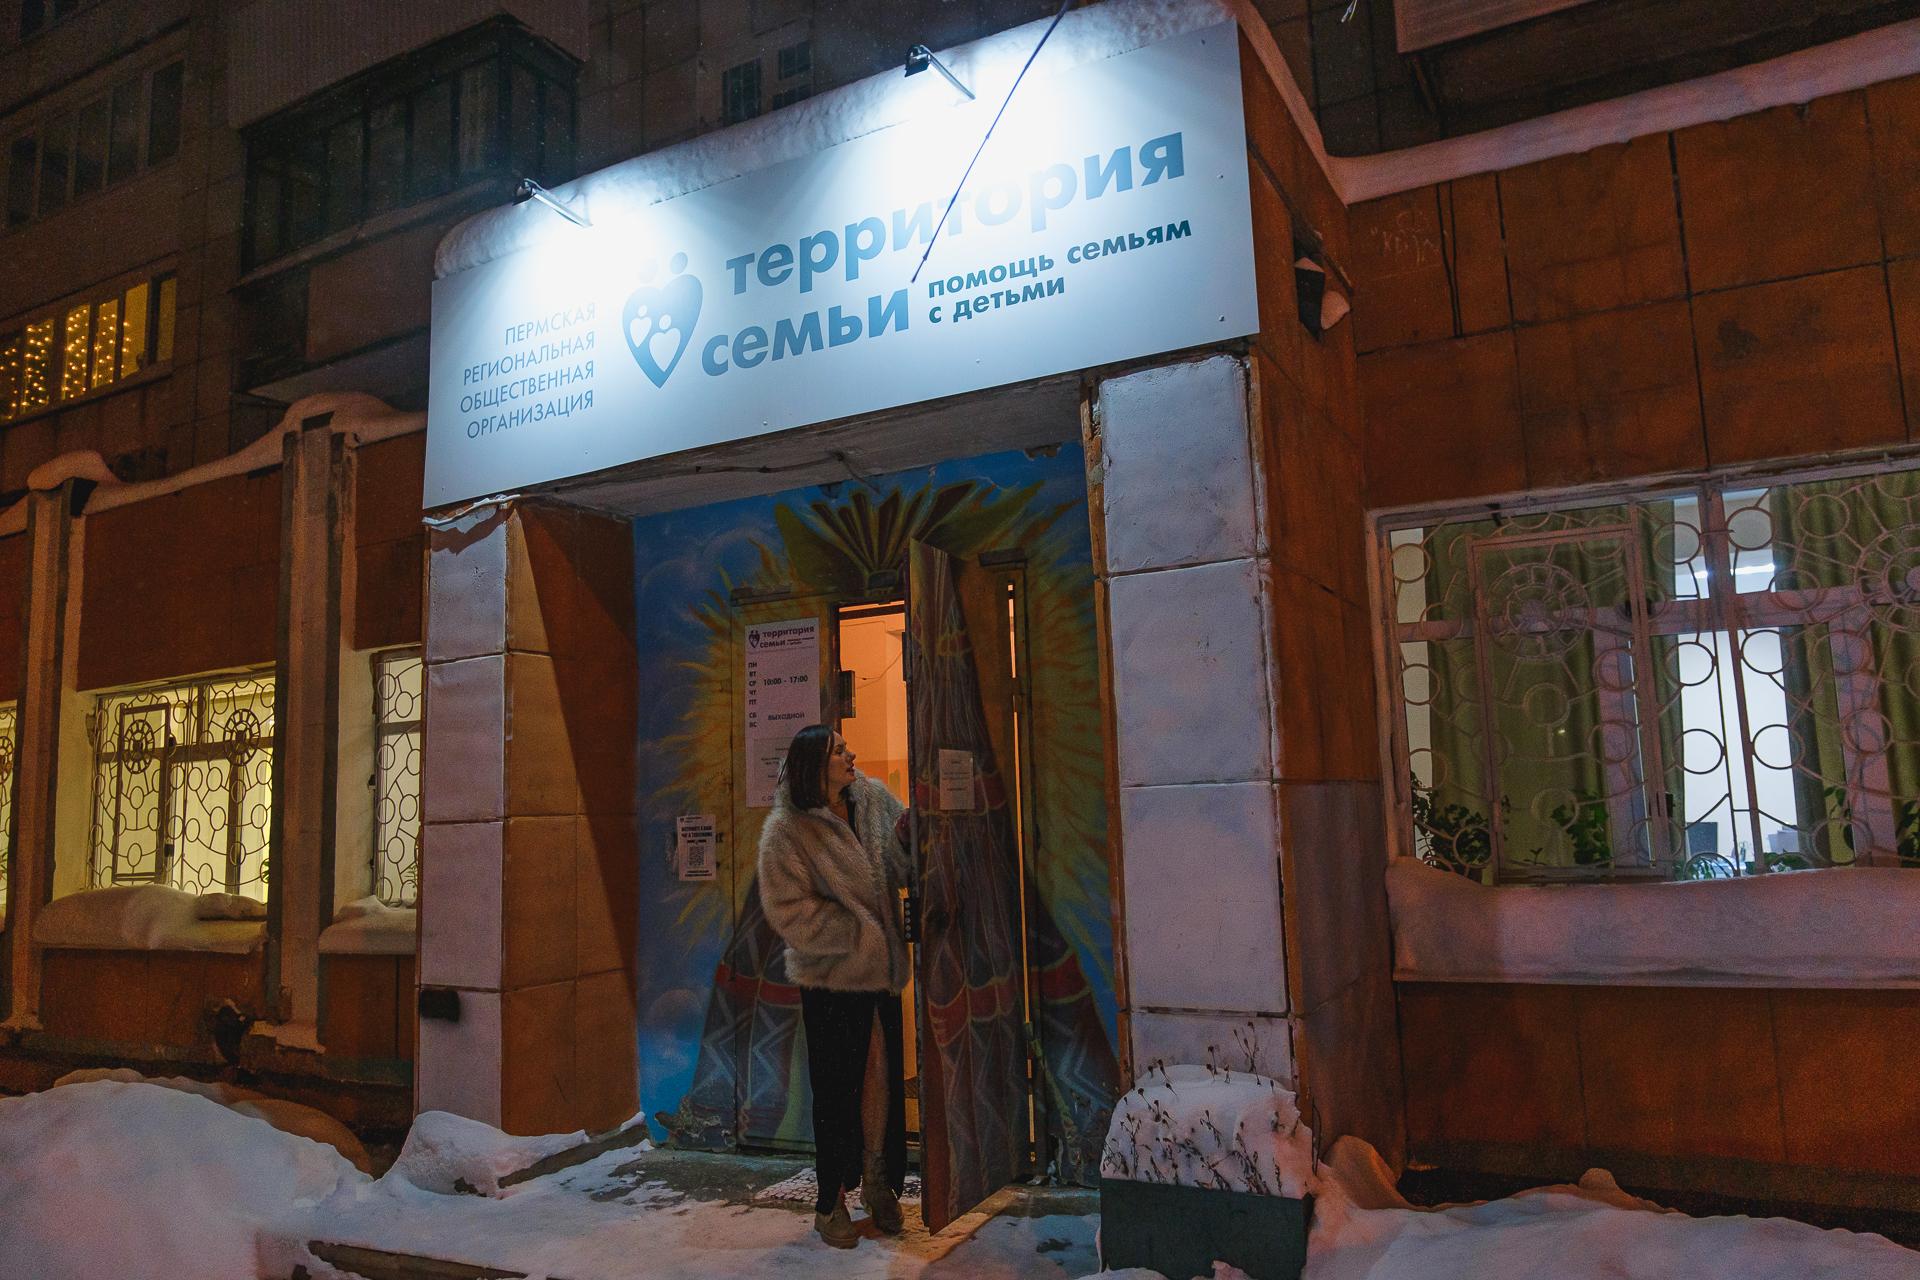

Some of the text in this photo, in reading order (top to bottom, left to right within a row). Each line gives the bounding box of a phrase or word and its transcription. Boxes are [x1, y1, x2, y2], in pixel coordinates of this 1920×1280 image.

[725, 131, 1185, 295] территория
[928, 220, 1192, 298] помощь семьям
[504, 302, 596, 346] ПЕРМСКАЯ
[928, 276, 1065, 325] с детьми
[701, 288, 910, 377] семьи
[463, 331, 595, 386] РЕГИОНАЛЬНАЯ
[460, 360, 594, 413] ОБЩЕСТВЕННАЯ
[467, 390, 593, 438] ОРГАНИЗАЦИЯ
[760, 640, 785, 648] семьи
[762, 626, 815, 638] территория
[763, 678, 782, 686] 10:00
[789, 675, 808, 683] 17:00
